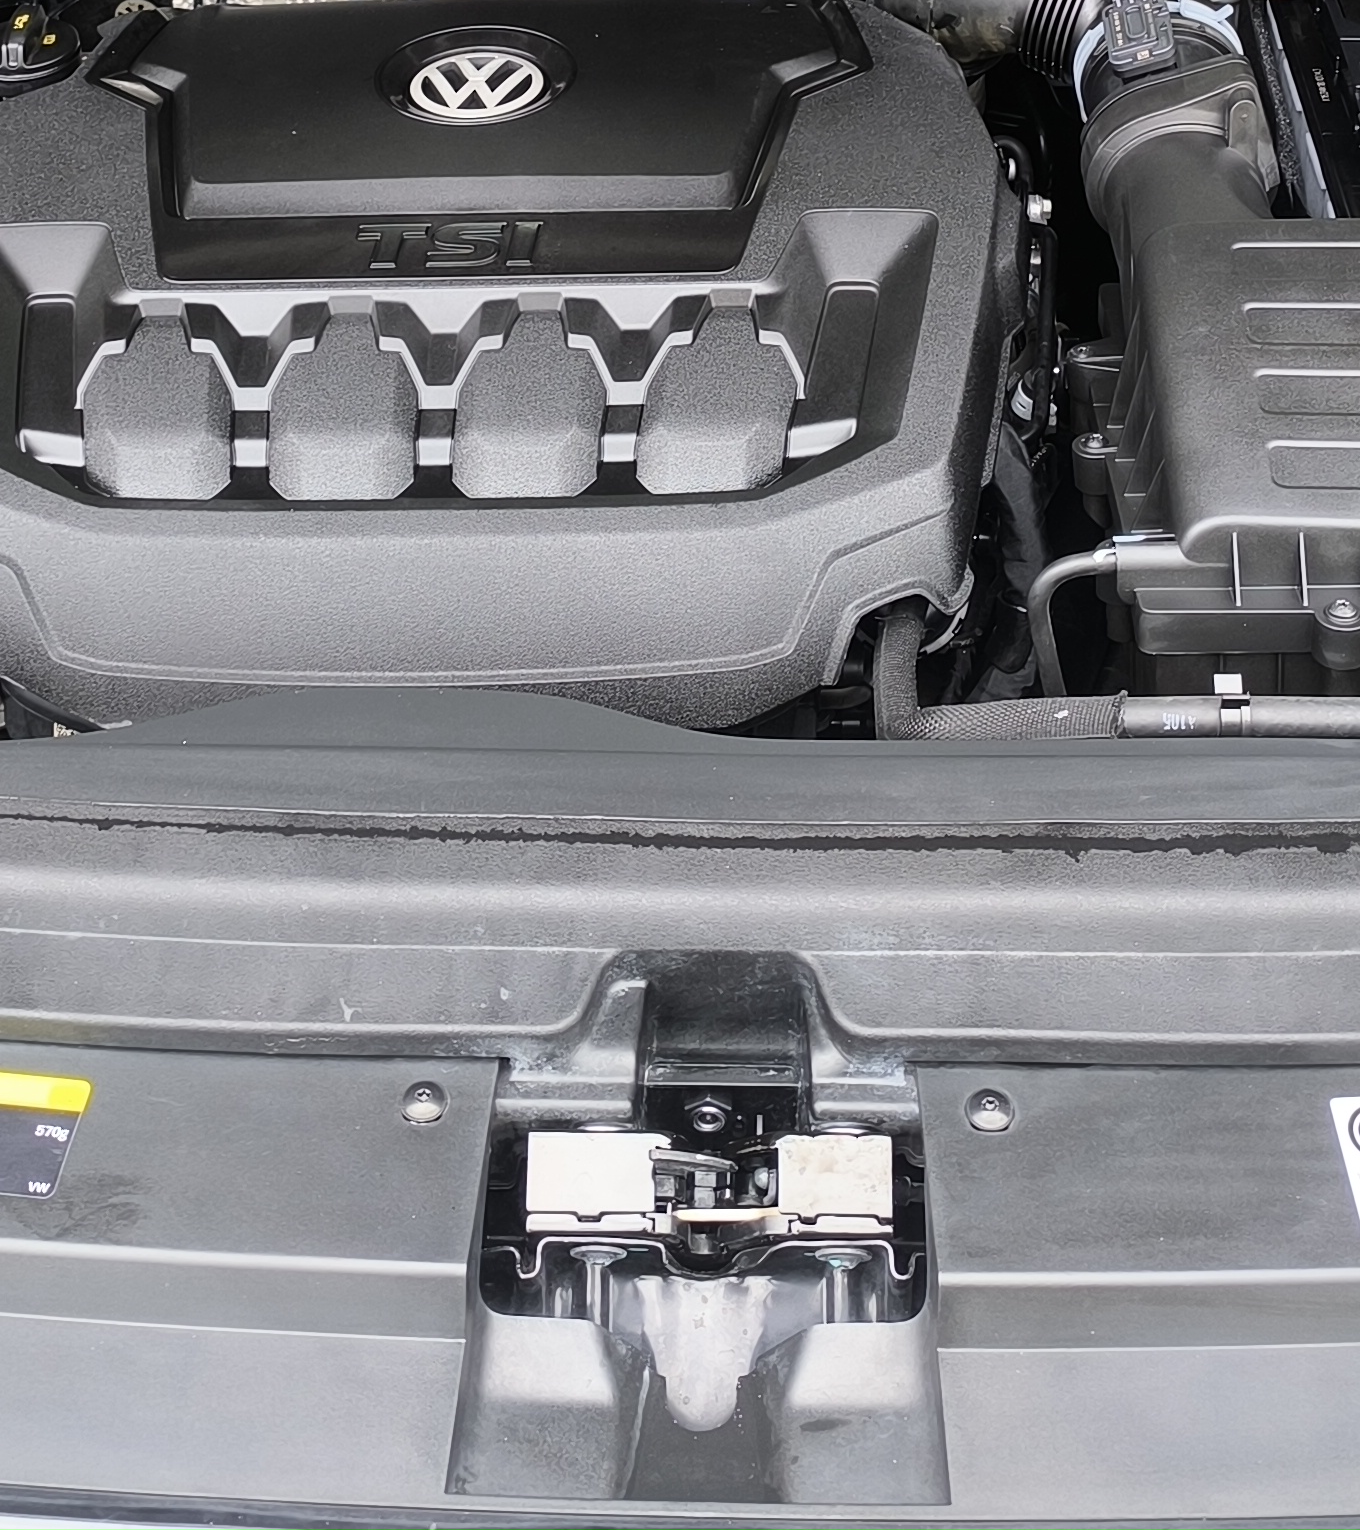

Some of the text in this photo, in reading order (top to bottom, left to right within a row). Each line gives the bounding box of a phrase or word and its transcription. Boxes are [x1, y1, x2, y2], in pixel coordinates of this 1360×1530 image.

[357, 221, 544, 269] TSI
[34, 1124, 70, 1142] 570g
[28, 1181, 51, 1194] VW
